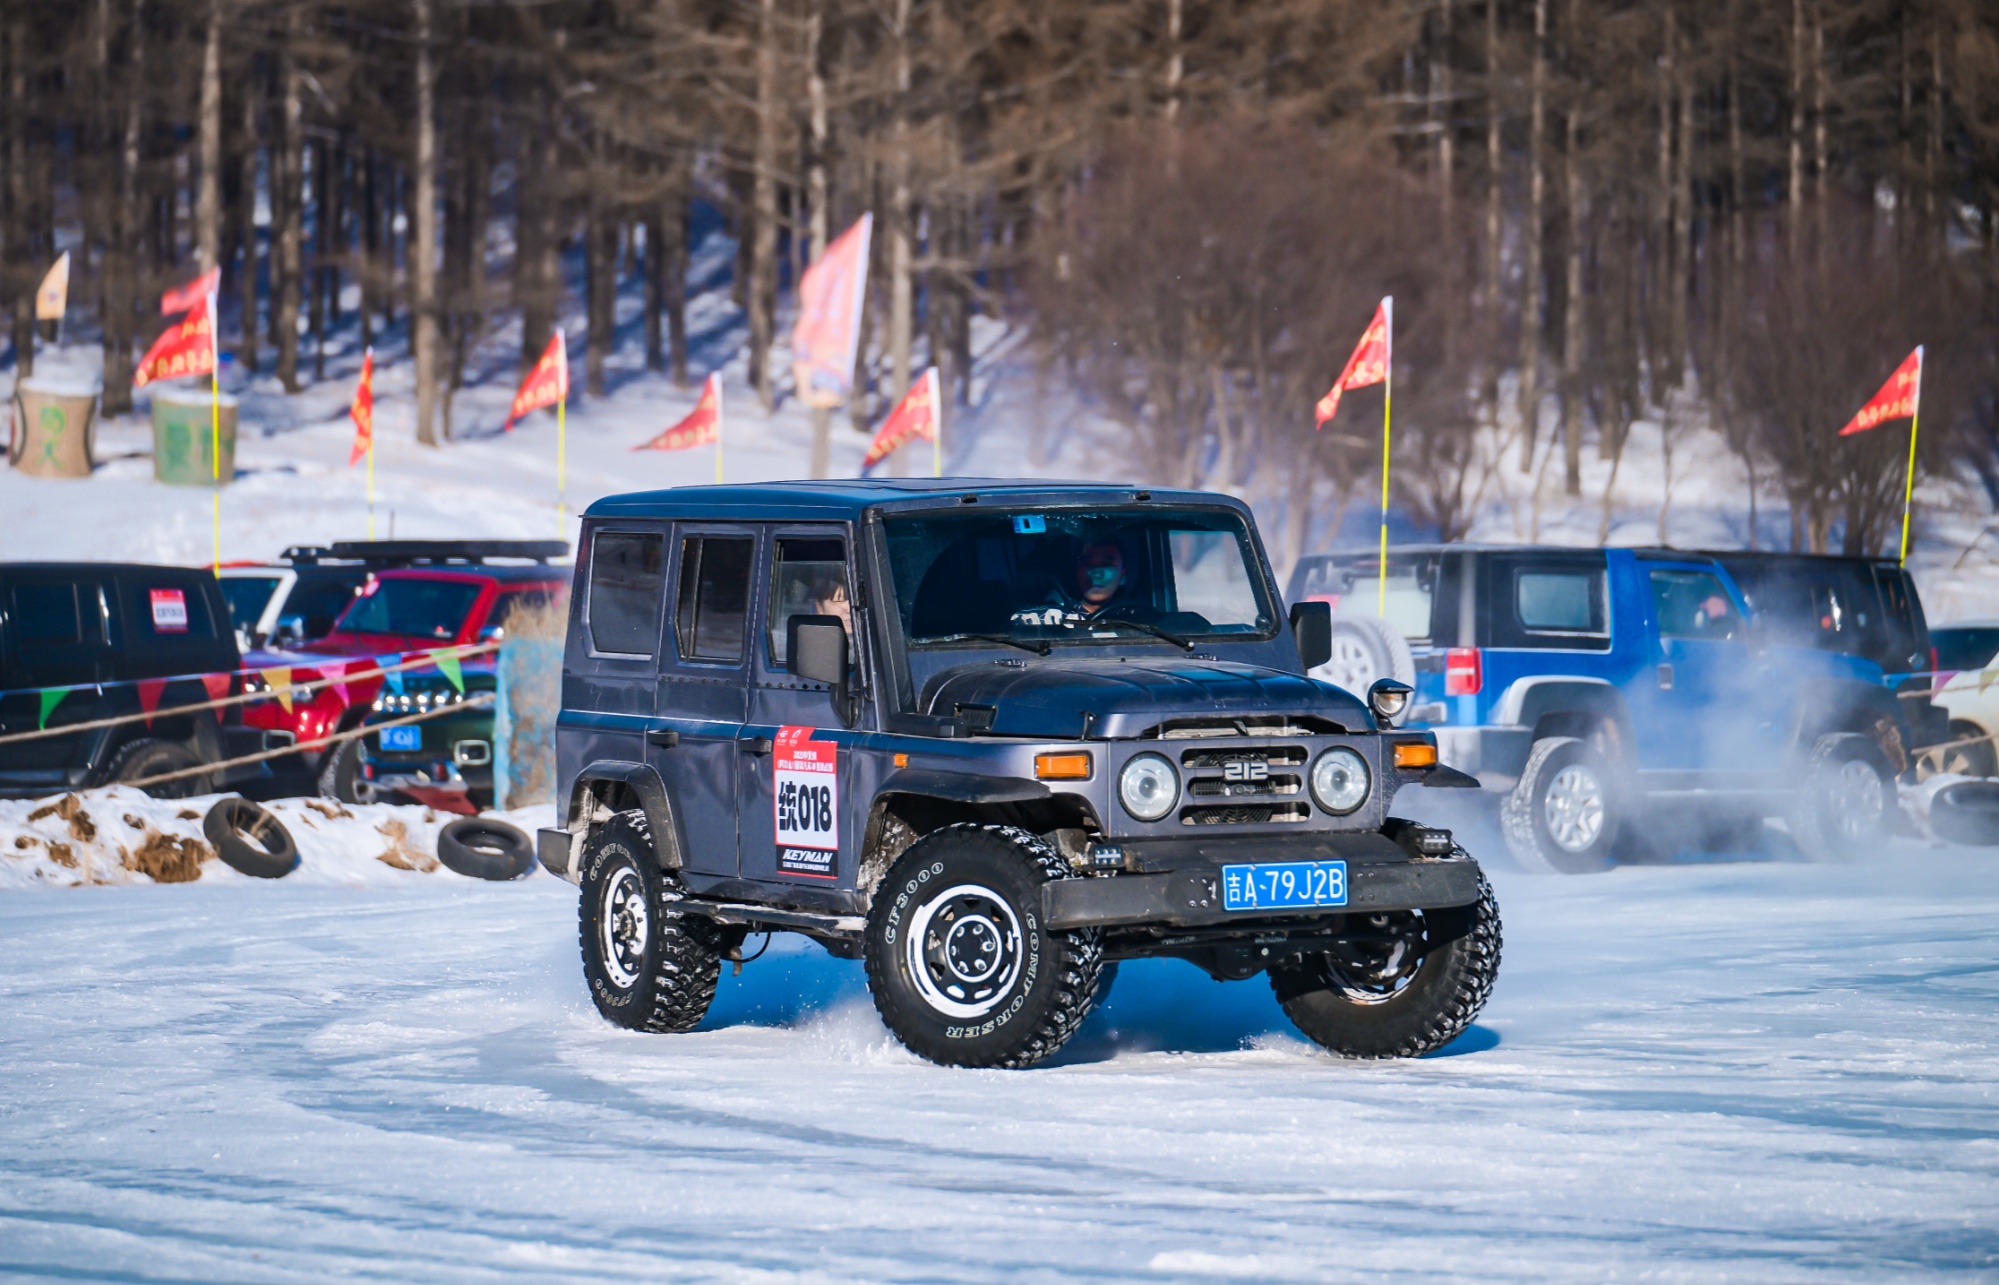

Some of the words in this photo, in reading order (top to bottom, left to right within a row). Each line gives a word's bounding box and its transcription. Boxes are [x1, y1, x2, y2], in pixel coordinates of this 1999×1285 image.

[1224, 762, 1269, 781] 212
[782, 848, 834, 864] KEYMAN
[884, 861, 944, 945] CF3000
[945, 912, 1040, 1038] COMFORSER
